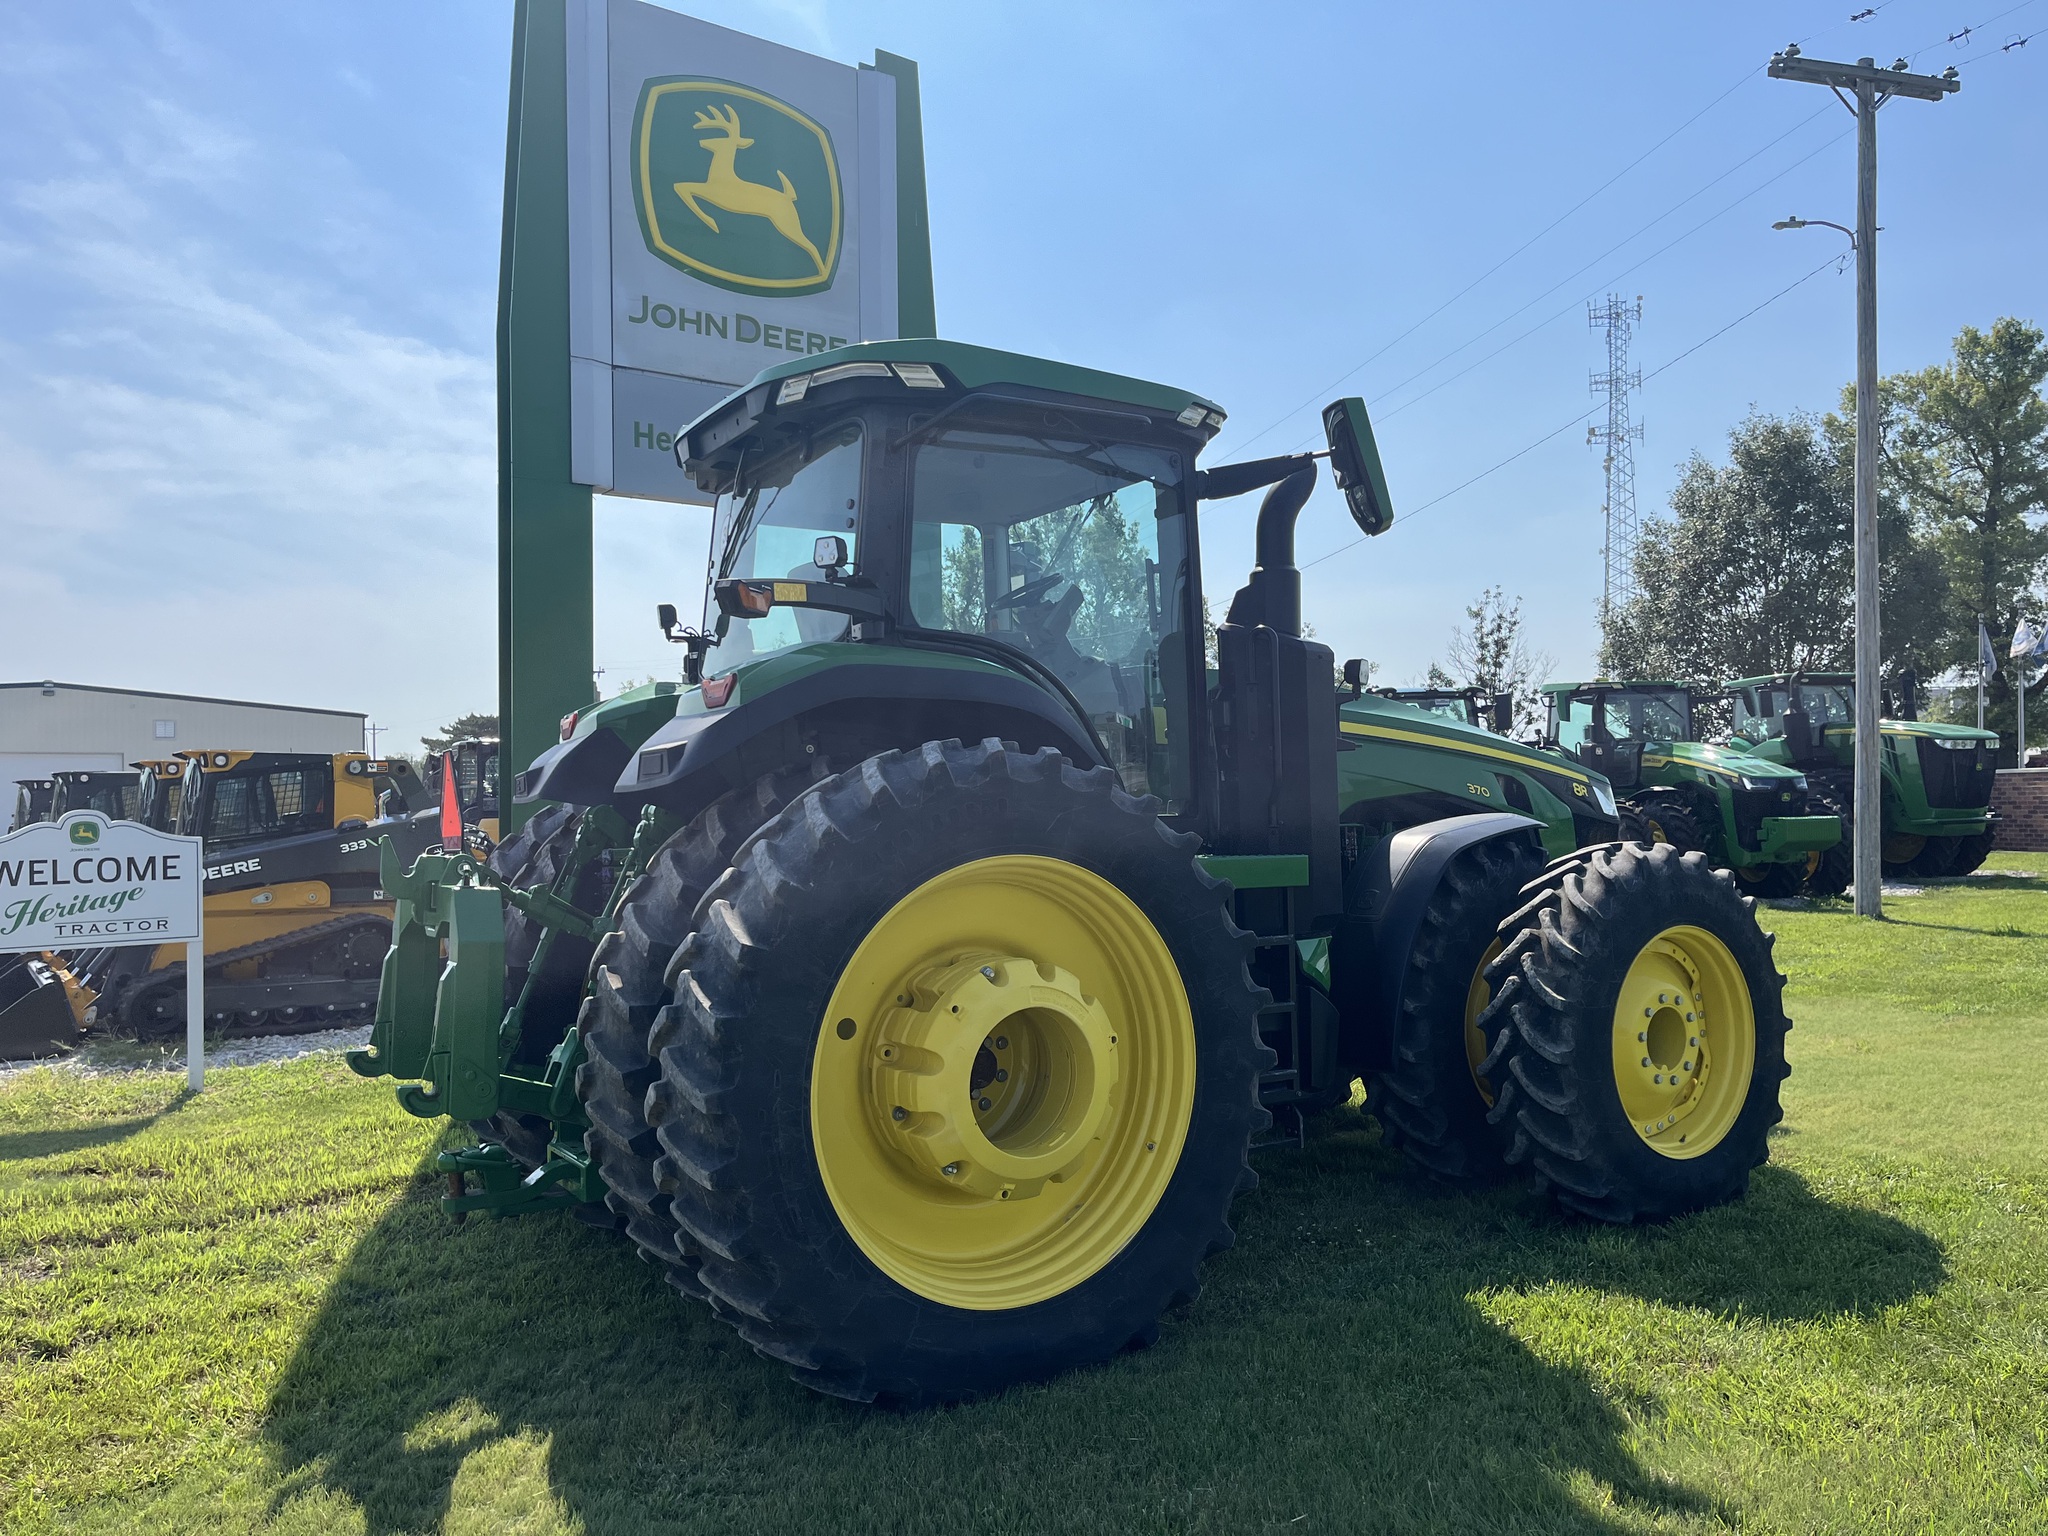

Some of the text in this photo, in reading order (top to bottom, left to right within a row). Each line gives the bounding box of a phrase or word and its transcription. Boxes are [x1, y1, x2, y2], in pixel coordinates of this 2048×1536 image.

[628, 295, 728, 340] JOHN
[633, 421, 678, 452] He
[1466, 782, 1490, 797] 370
[1572, 782, 1589, 796] 8R
[340, 839, 368, 853] 333
[0, 855, 181, 887] WELCOME
[1, 886, 146, 935] Heritage
[55, 919, 168, 936] TRACTOR
